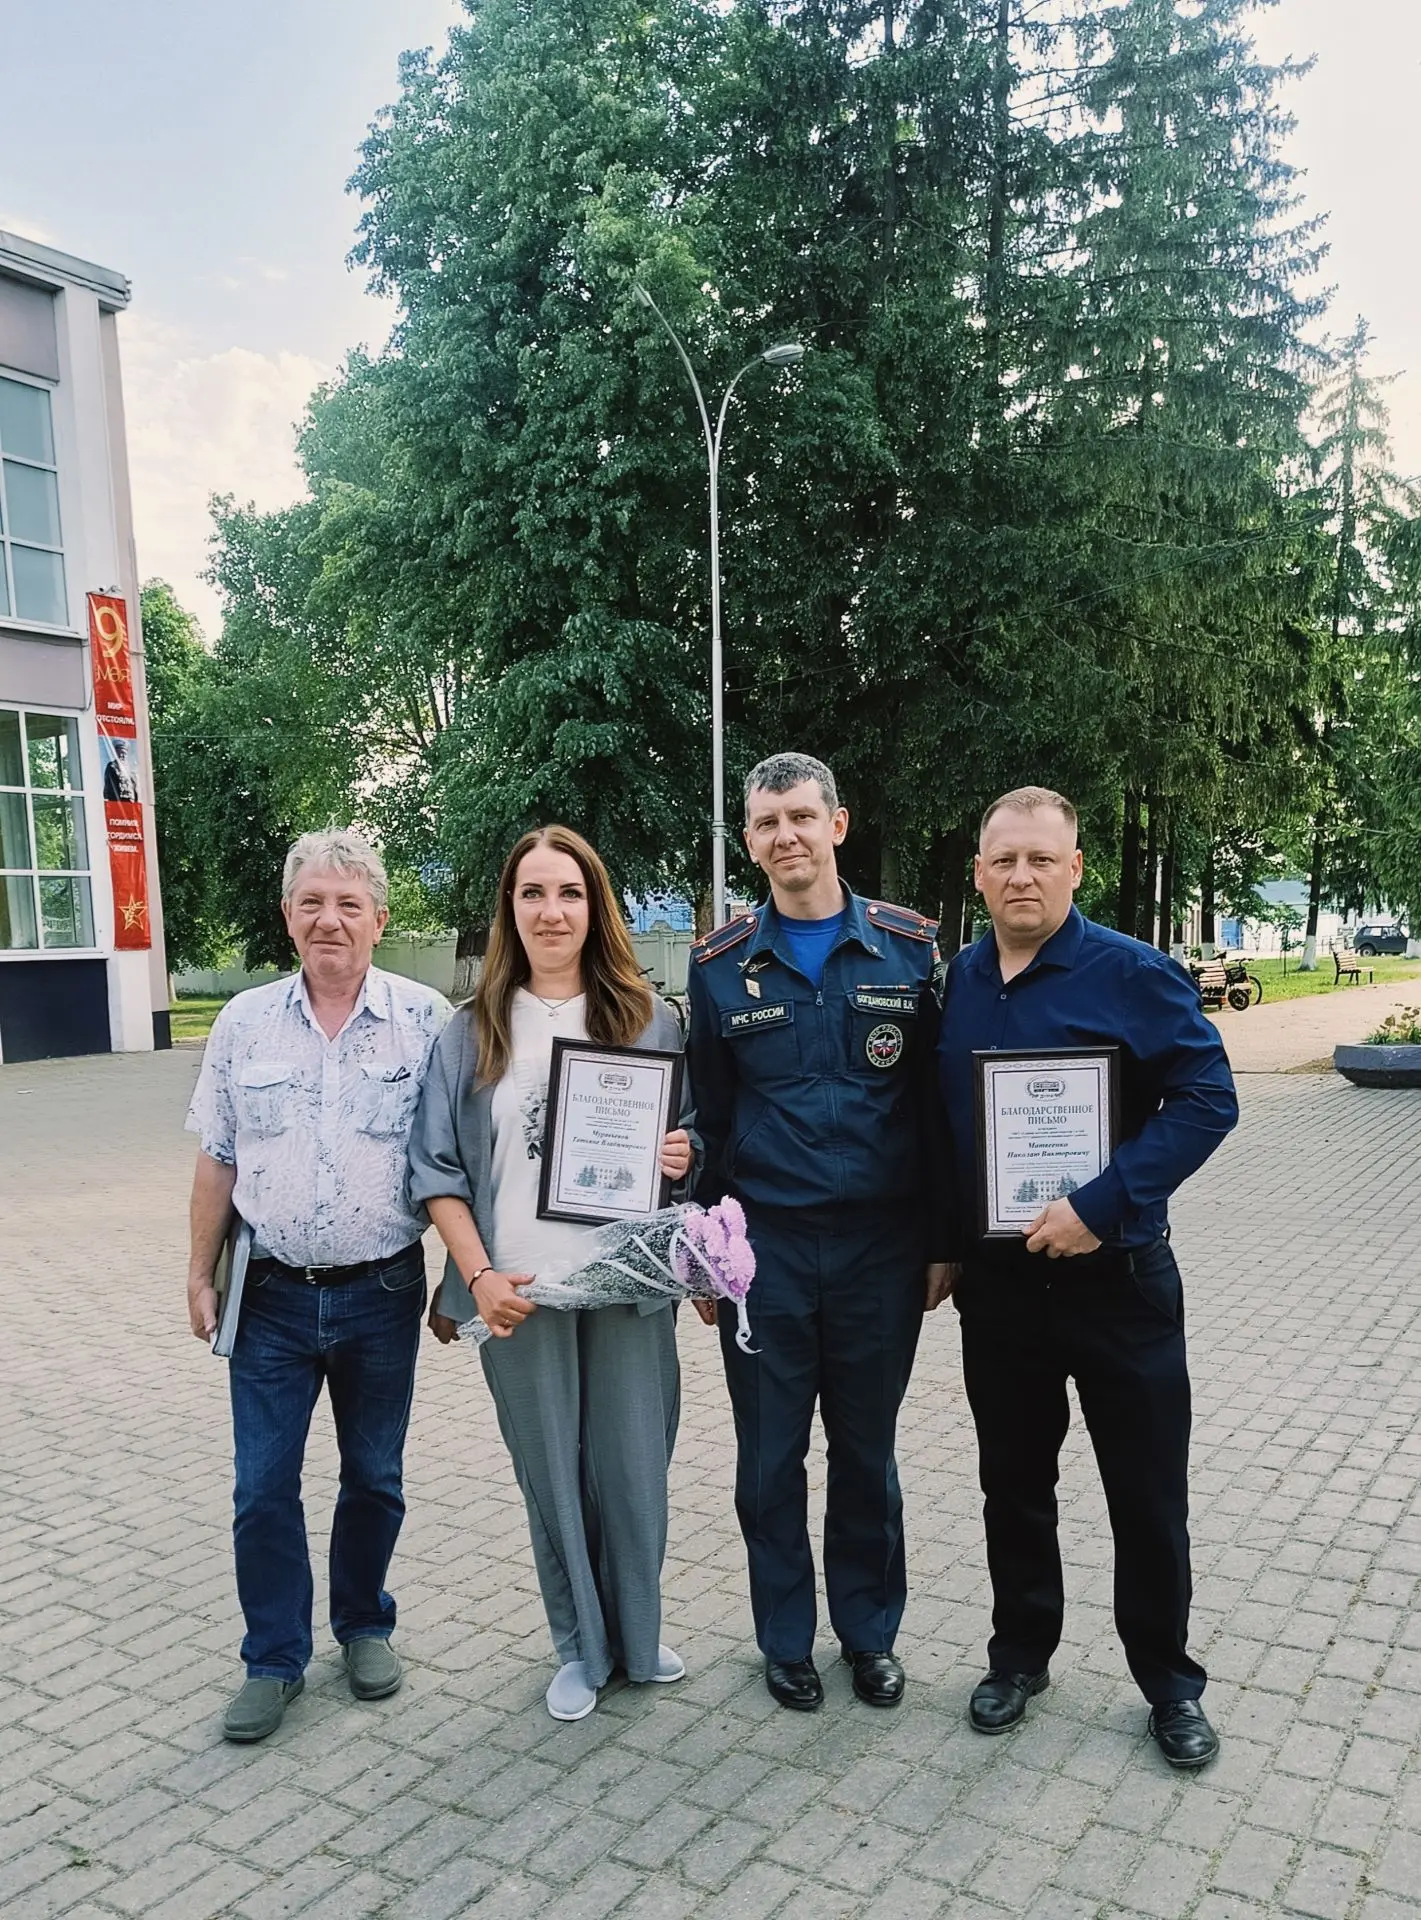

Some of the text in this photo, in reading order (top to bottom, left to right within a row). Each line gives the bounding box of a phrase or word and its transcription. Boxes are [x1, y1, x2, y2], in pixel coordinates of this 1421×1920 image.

[96, 606, 125, 658] 9
[731, 1006, 784, 1026] МЧС РОССИИ
[572, 1093, 655, 1111] БЛАГОДАРСТВЕННОЕ
[595, 1105, 631, 1118] ПИСЬМО
[1001, 1104, 1094, 1116] БЛАГОДАРСТВЕННОЕ
[1027, 1115, 1067, 1125] ПИСЬМО
